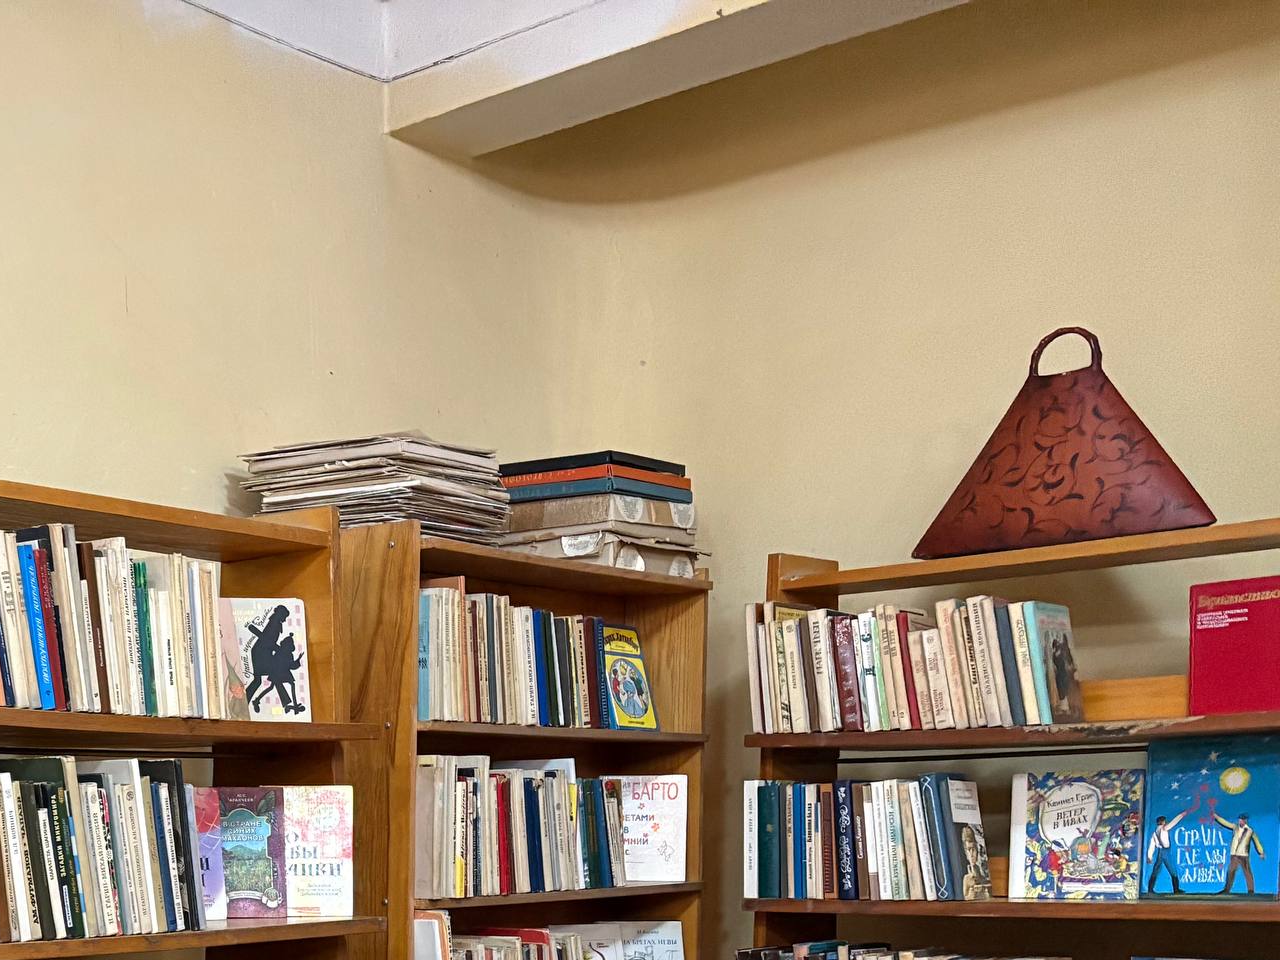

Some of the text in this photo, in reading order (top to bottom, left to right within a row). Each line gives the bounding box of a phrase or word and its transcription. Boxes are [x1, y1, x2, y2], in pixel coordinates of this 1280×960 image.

[631, 782, 679, 801] БАРТО
[50, 794, 67, 878] ЗАГАДКИ МИКРОМИРА
